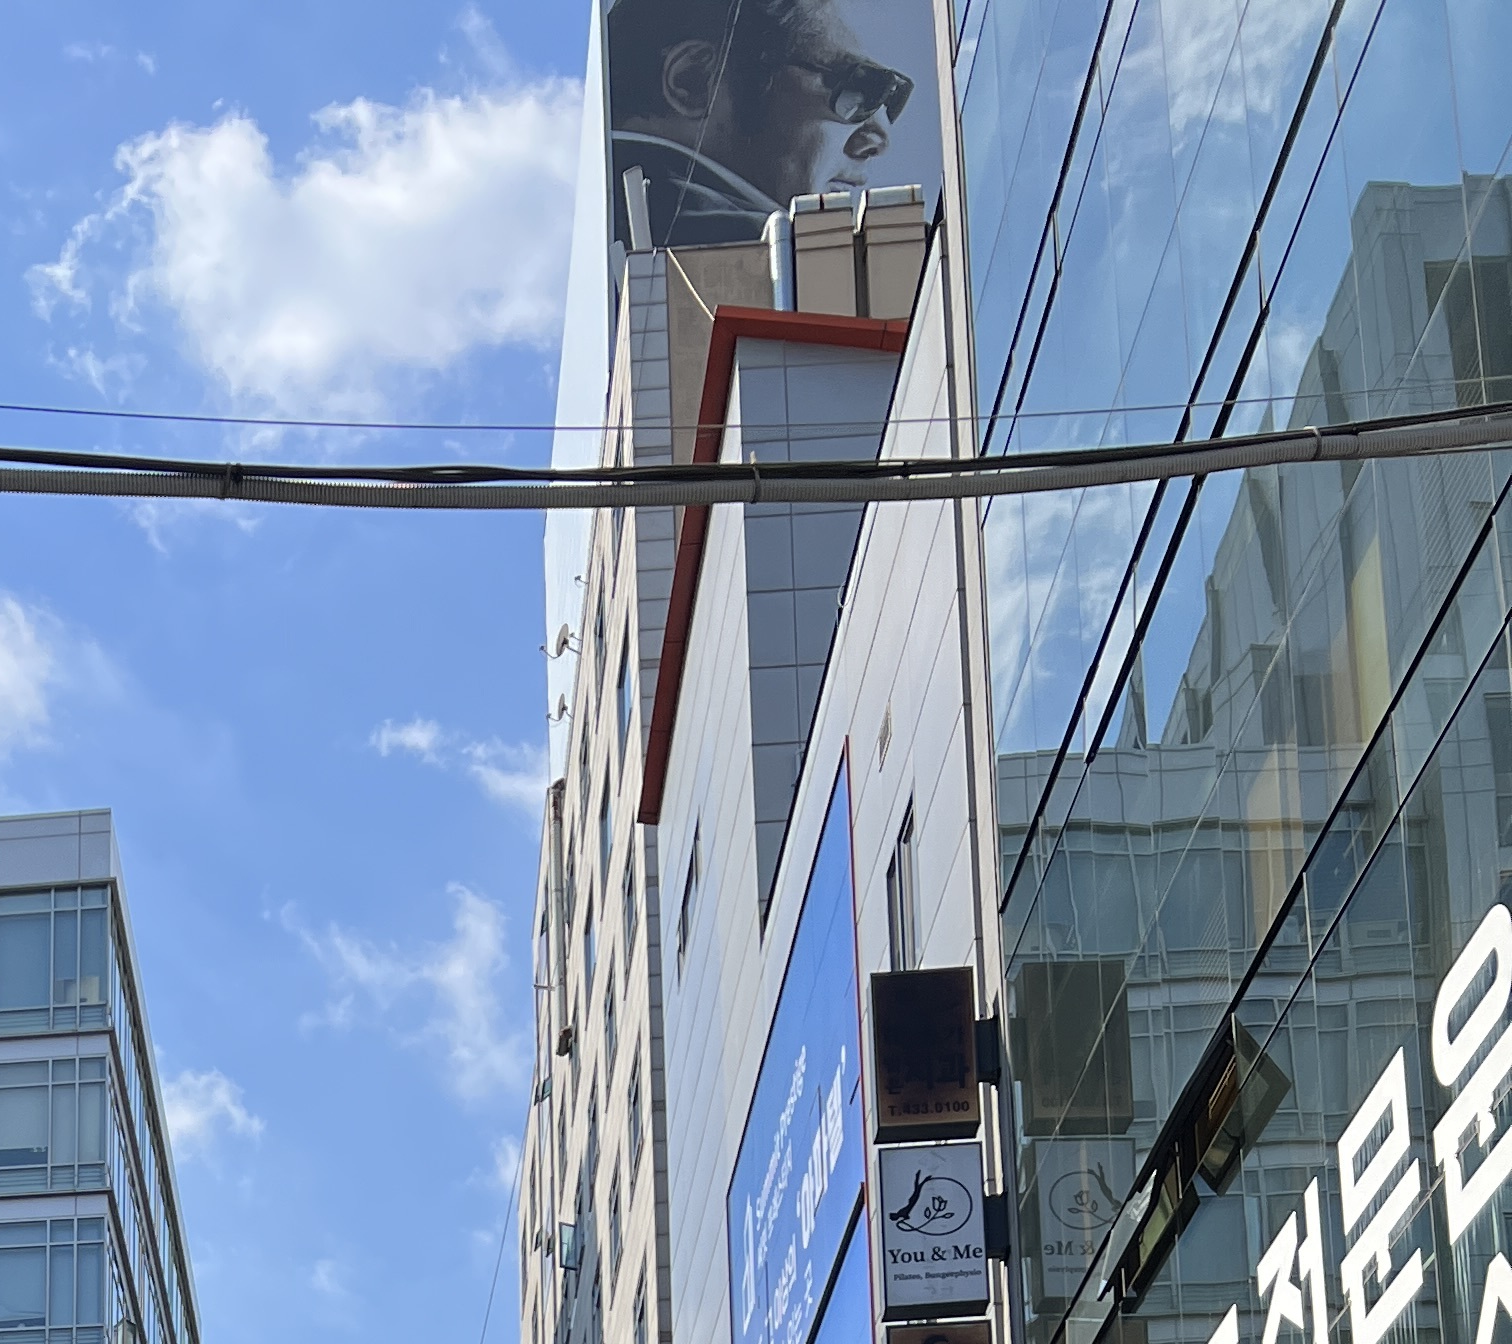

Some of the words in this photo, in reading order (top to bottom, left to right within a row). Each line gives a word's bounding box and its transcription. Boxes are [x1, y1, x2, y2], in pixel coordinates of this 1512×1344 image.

[888, 1249, 925, 1264] You
[931, 1246, 946, 1261] &
[952, 1244, 983, 1260] Me
